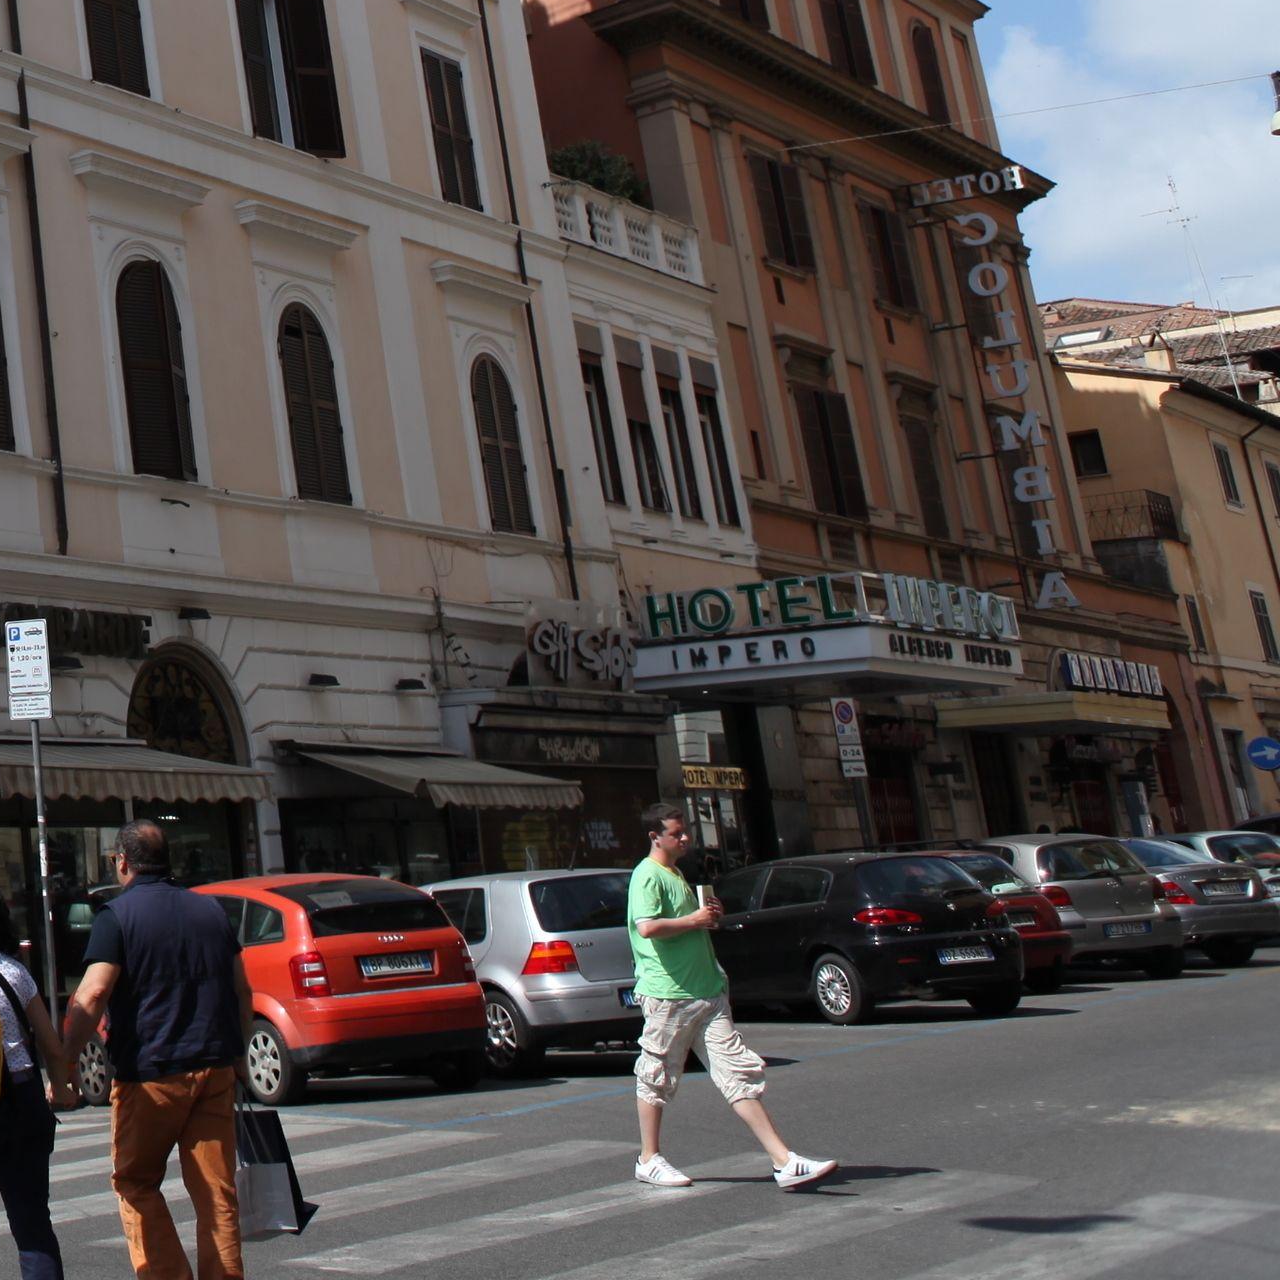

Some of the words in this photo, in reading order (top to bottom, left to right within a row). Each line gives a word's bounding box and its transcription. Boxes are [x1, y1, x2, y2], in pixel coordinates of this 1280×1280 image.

[645, 574, 858, 638] HOTEL
[671, 636, 816, 670] IMPERO
[842, 748, 861, 756] 0-24
[370, 956, 384, 971] BP
